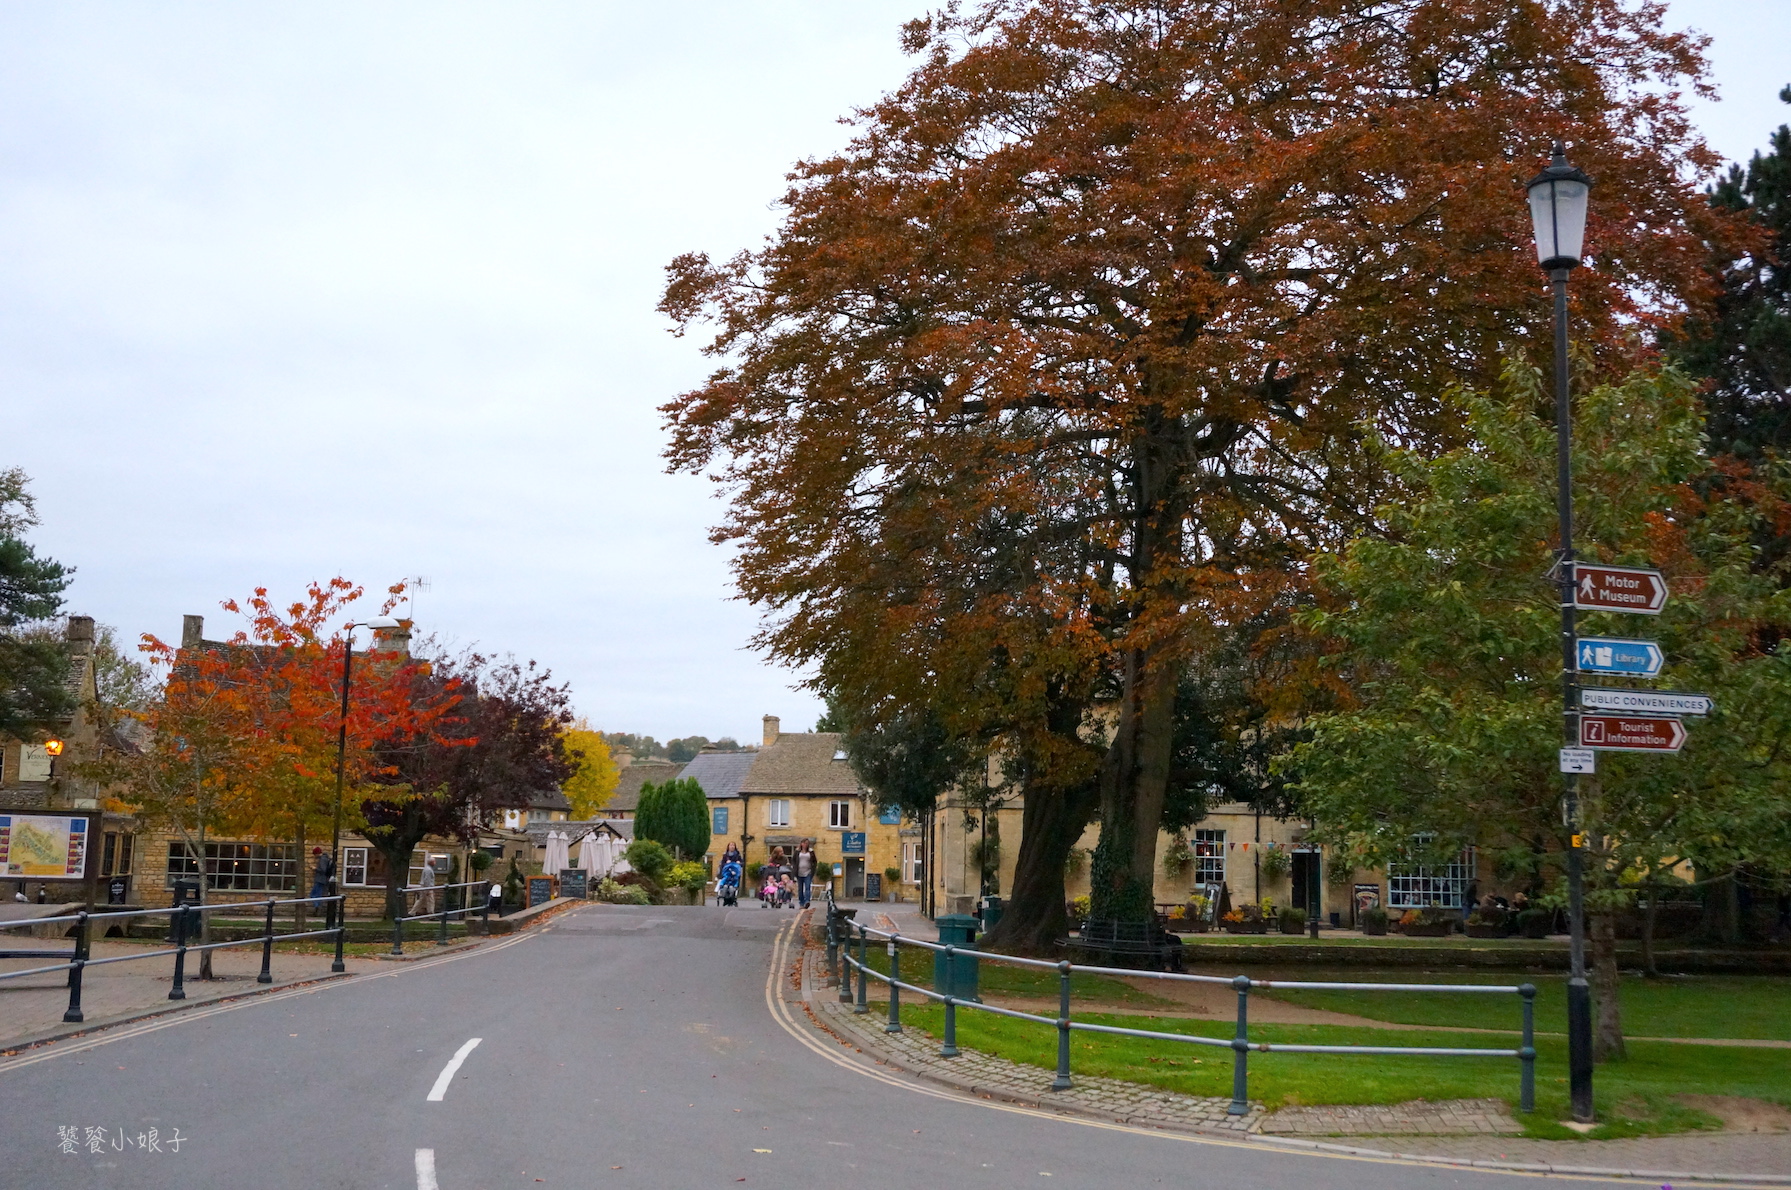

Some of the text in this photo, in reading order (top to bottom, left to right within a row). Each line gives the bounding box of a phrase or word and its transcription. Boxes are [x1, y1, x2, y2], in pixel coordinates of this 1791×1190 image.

[1605, 575, 1640, 589] Motor
[1600, 589, 1646, 604] Museum
[1615, 653, 1646, 665] Library
[1584, 694, 1704, 710] PUBLIC CONVENIENCES
[1618, 721, 1655, 733] Tourist
[1607, 733, 1667, 745] Information
